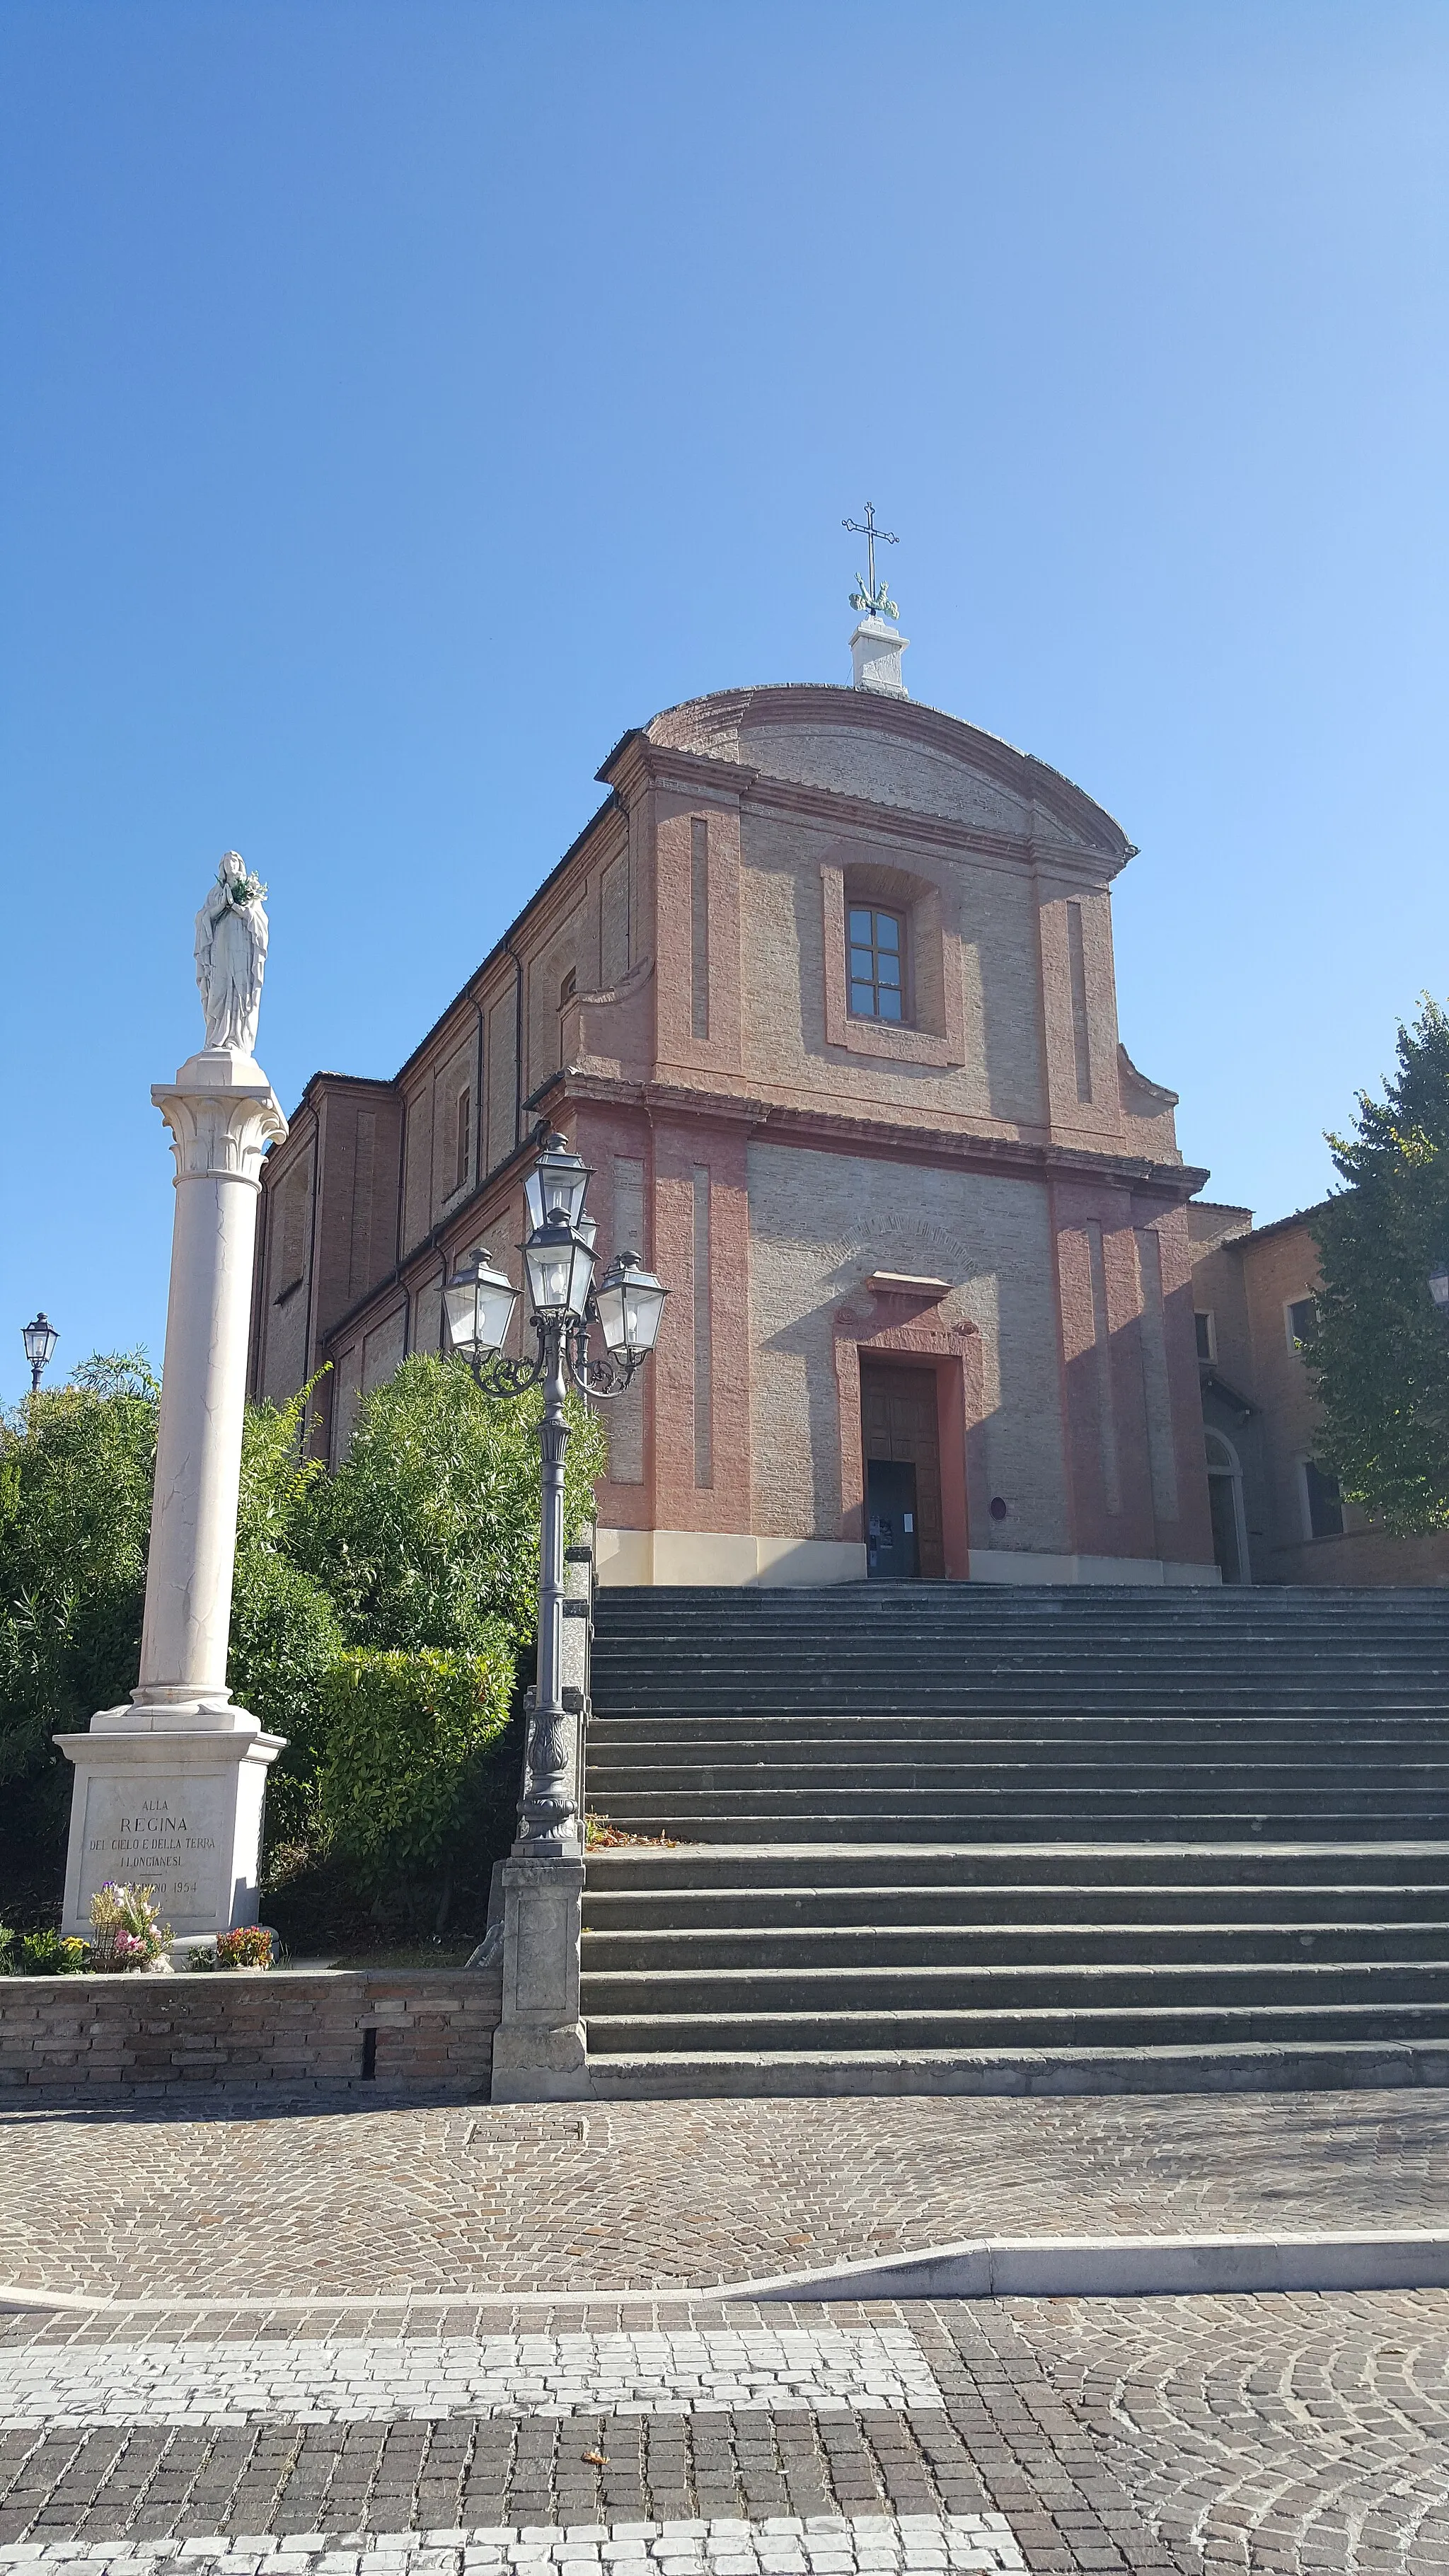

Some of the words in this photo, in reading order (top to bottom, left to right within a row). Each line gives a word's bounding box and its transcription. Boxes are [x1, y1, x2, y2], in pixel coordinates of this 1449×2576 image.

[142, 1801, 168, 1810] ALLA
[120, 1818, 187, 1832] REGINA
[90, 1839, 105, 1850] DEL
[112, 1839, 139, 1850] CIELO
[143, 1839, 149, 1849] E
[151, 1838, 181, 1849] DELLA
[185, 1837, 215, 1849] TERRA
[174, 1882, 197, 1893] 1954
